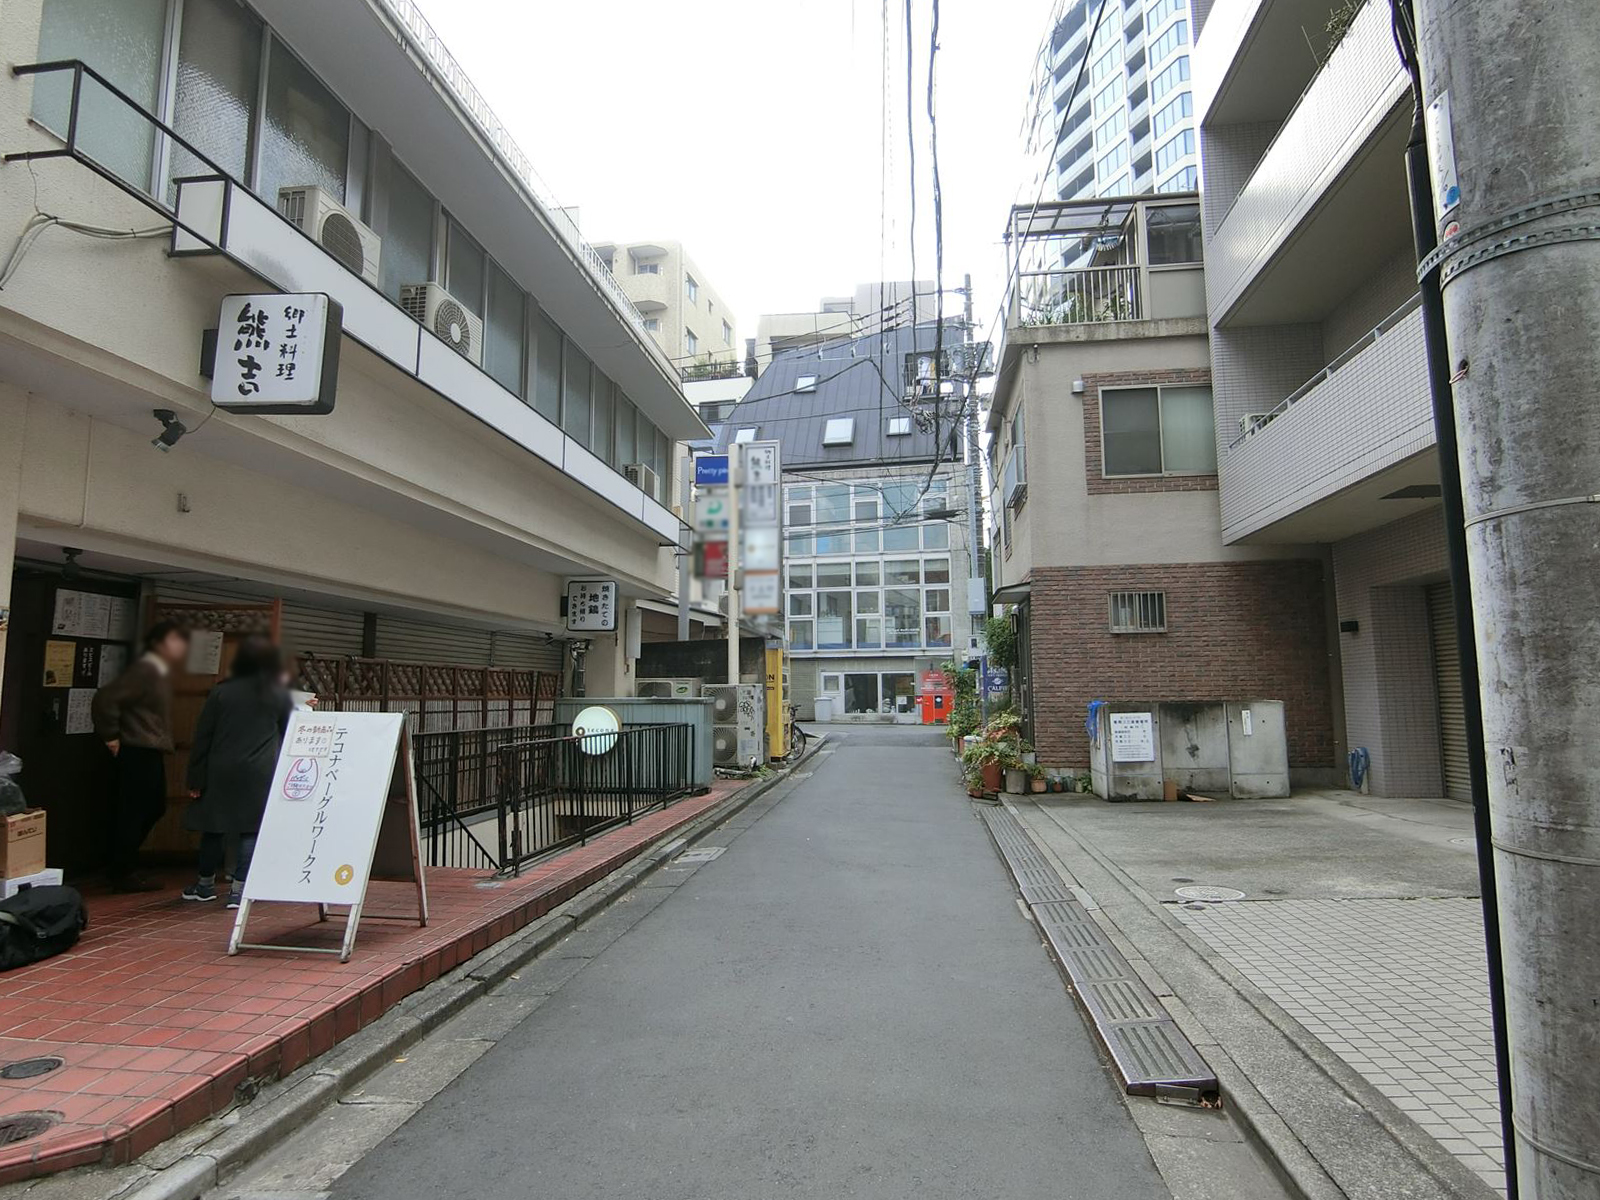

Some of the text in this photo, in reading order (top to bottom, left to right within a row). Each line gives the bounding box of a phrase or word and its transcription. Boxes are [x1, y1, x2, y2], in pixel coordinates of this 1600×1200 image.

[275, 305, 305, 381] 郷土料理
[298, 727, 348, 885] テコナベーグルワークス
